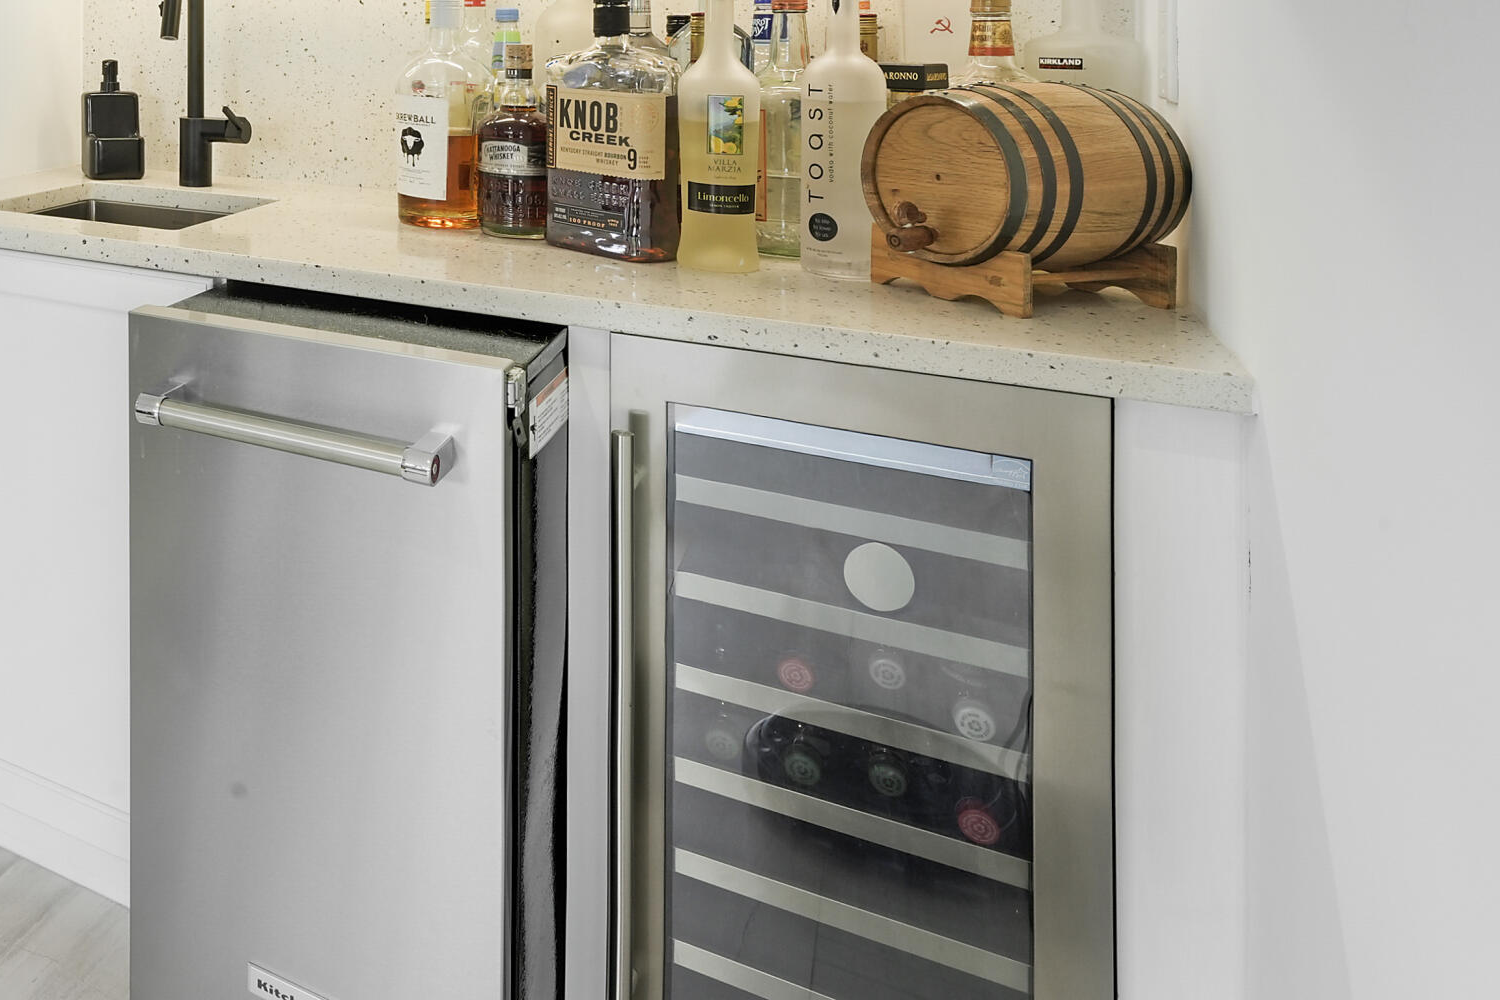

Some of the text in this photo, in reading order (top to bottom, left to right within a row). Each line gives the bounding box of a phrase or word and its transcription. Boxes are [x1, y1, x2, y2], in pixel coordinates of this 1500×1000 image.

[1040, 58, 1082, 66] KIRKLAND
[560, 98, 618, 133] KNOB
[569, 130, 630, 147] CREEK
[604, 152, 626, 160] BOURBON
[627, 148, 637, 170] 9
[827, 160, 835, 183] vodka
[698, 191, 749, 203] Limoncello
[569, 216, 581, 224] 100
[583, 219, 606, 228] PROOF
